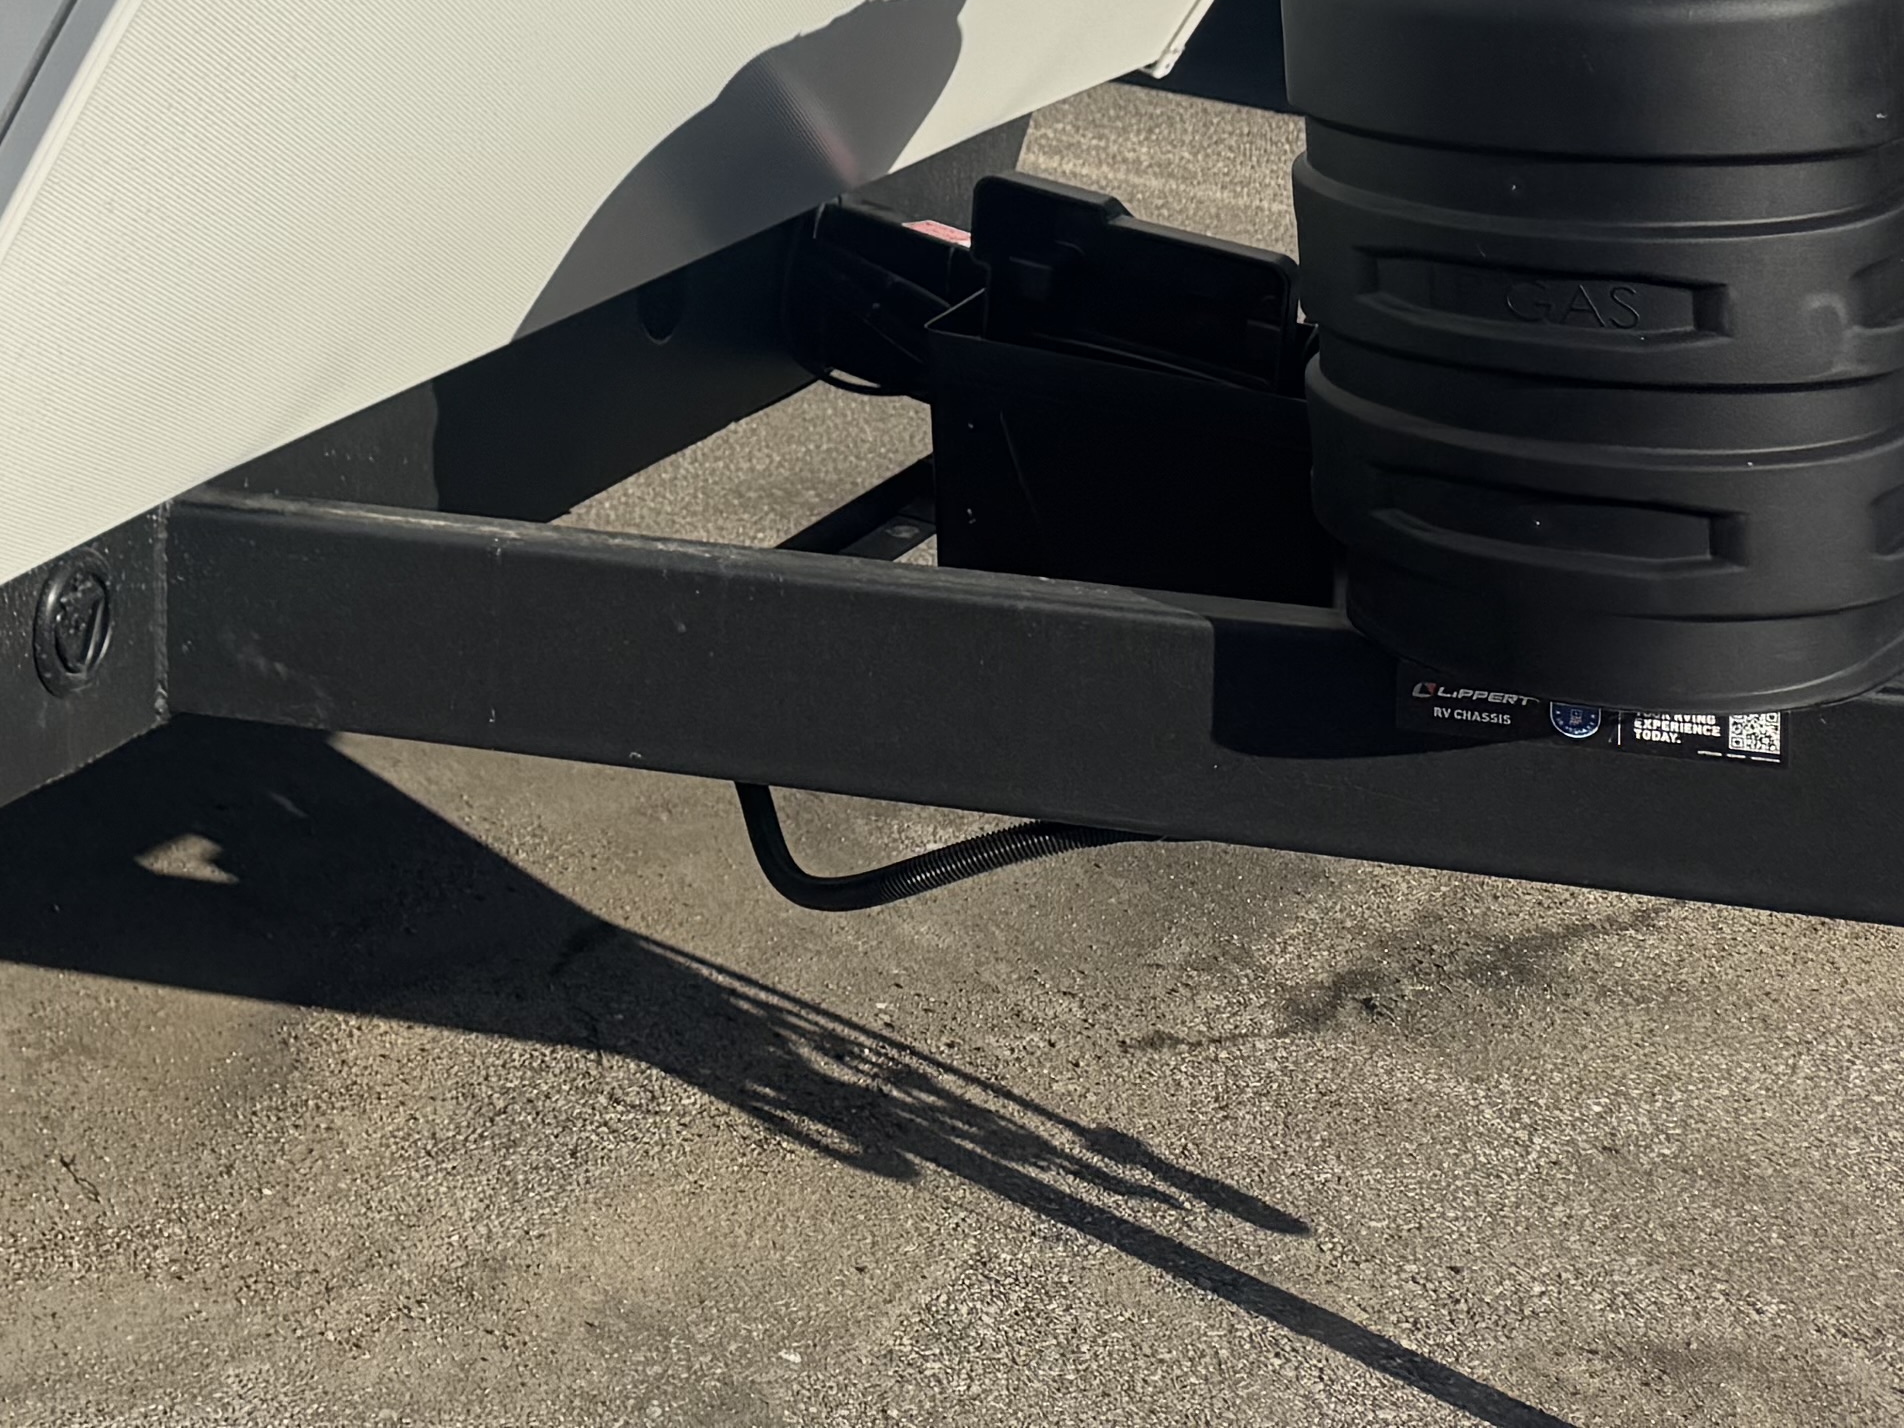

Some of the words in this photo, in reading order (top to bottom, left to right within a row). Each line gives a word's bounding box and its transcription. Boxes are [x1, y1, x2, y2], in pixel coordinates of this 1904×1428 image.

[1506, 279, 1641, 329] GAS
[1433, 706, 1451, 720] RV
[1453, 709, 1512, 725] CHASSIS
[1633, 728, 1682, 744] TODAY.
[1634, 718, 1721, 737] EXPERIENCE
